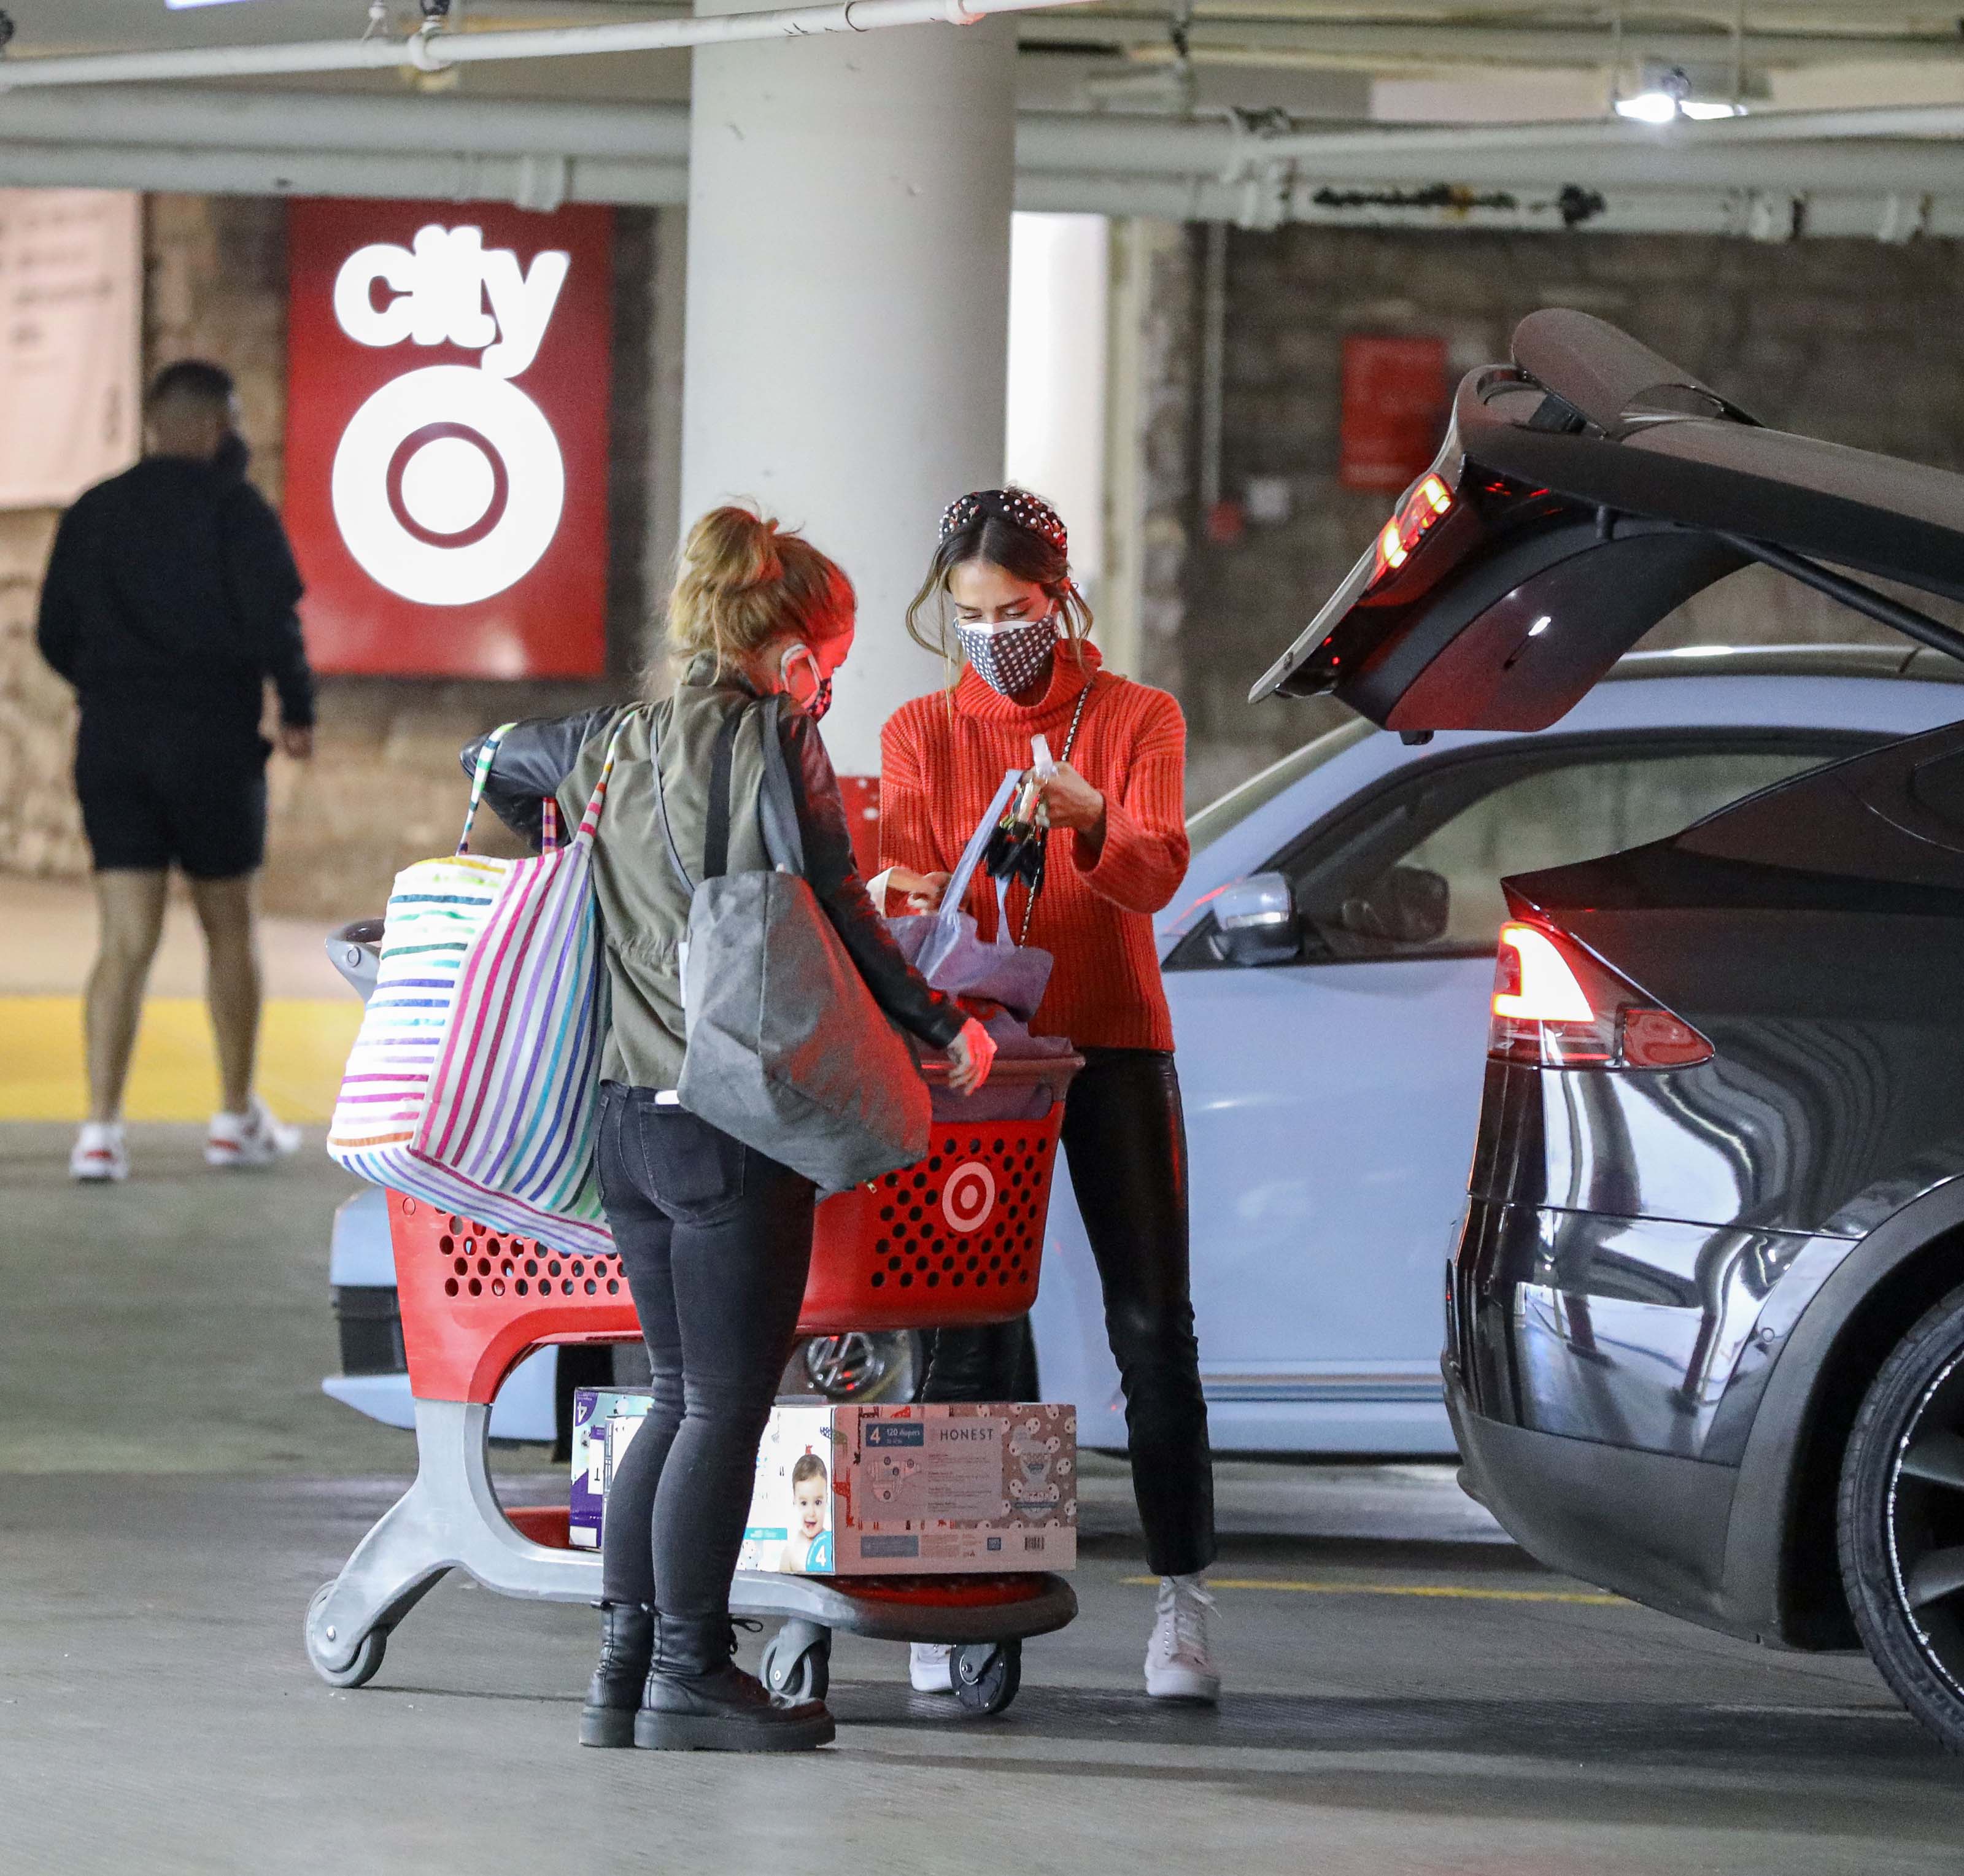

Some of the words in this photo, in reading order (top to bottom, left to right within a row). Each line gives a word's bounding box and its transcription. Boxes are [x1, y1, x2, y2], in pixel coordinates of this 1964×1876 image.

[333, 223, 571, 379] city
[870, 1426, 881, 1444] 4
[940, 1428, 994, 1441] HONEST
[815, 1545, 827, 1567] 4
